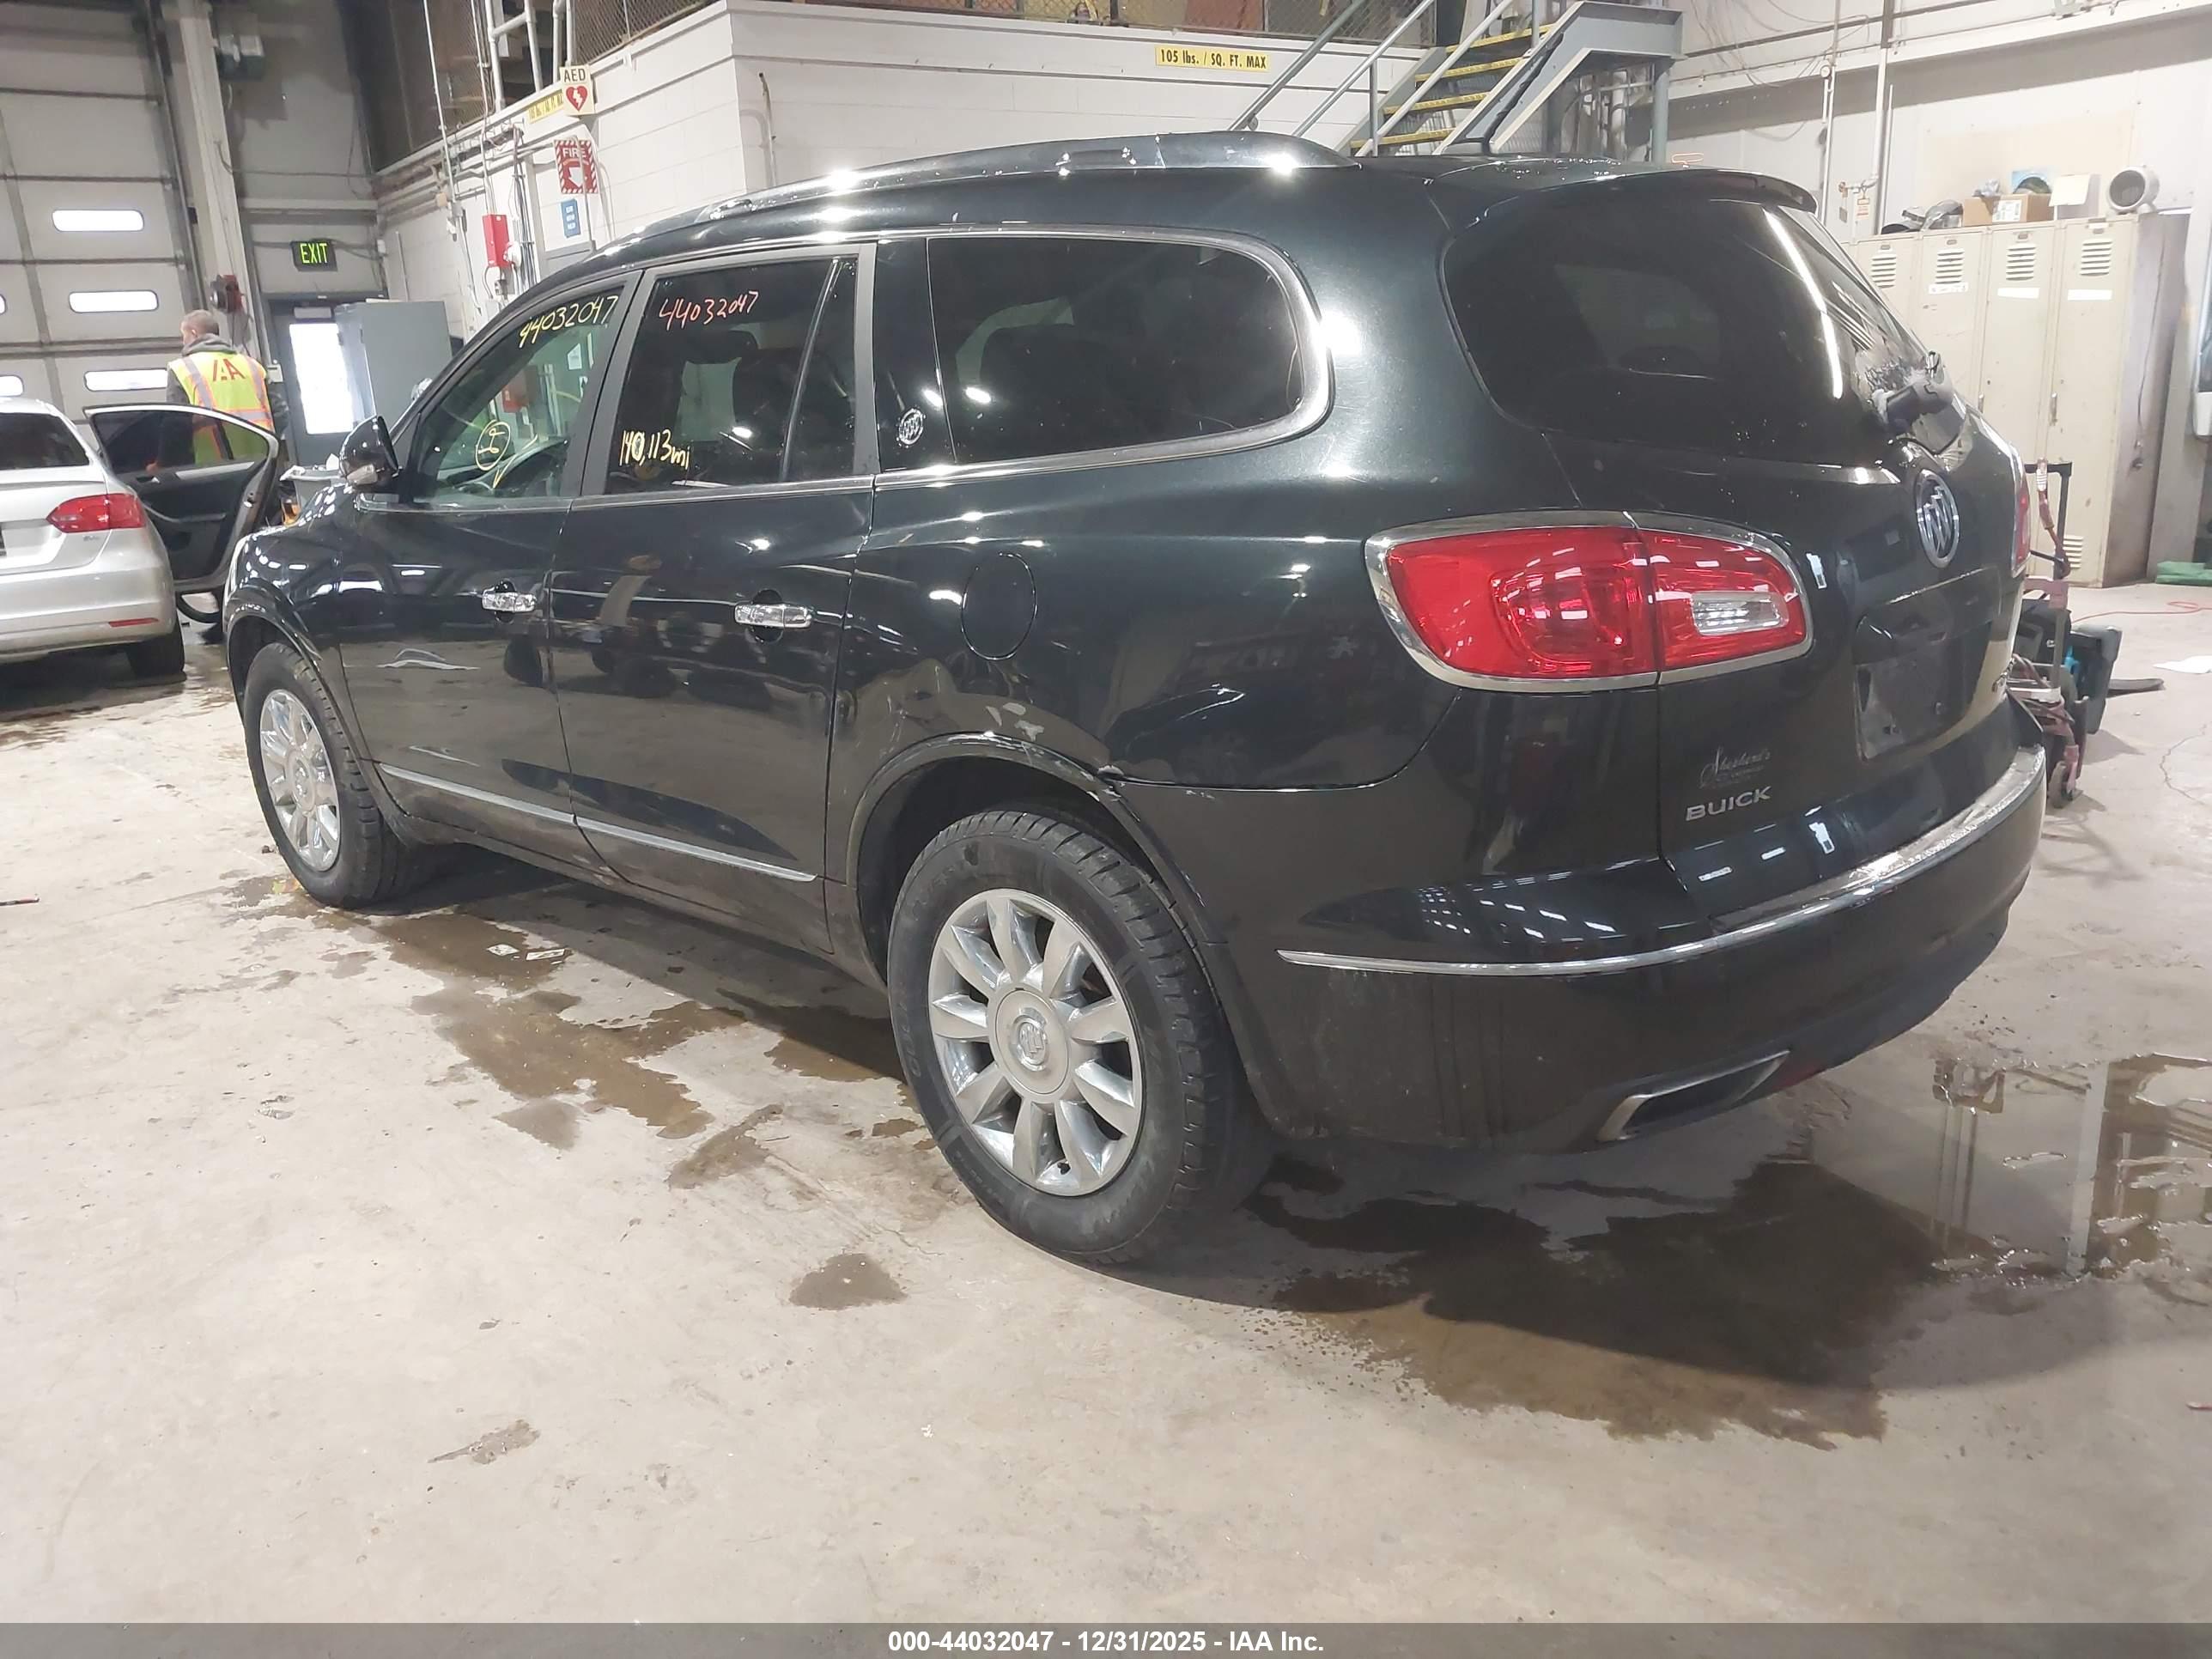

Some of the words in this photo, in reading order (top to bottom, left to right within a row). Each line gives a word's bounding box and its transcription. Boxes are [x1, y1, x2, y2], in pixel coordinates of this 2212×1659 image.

[1160, 49, 1178, 63] 105
[1182, 50, 1200, 64] lbs.
[1211, 52, 1225, 67] SQ.
[1230, 54, 1243, 68] FT.
[1246, 56, 1267, 69] MAX
[563, 68, 586, 82] AED
[300, 243, 328, 264] EXIT
[519, 295, 619, 349] 44032047
[659, 290, 759, 331] 44032047
[1686, 785, 1771, 822] BUICK
